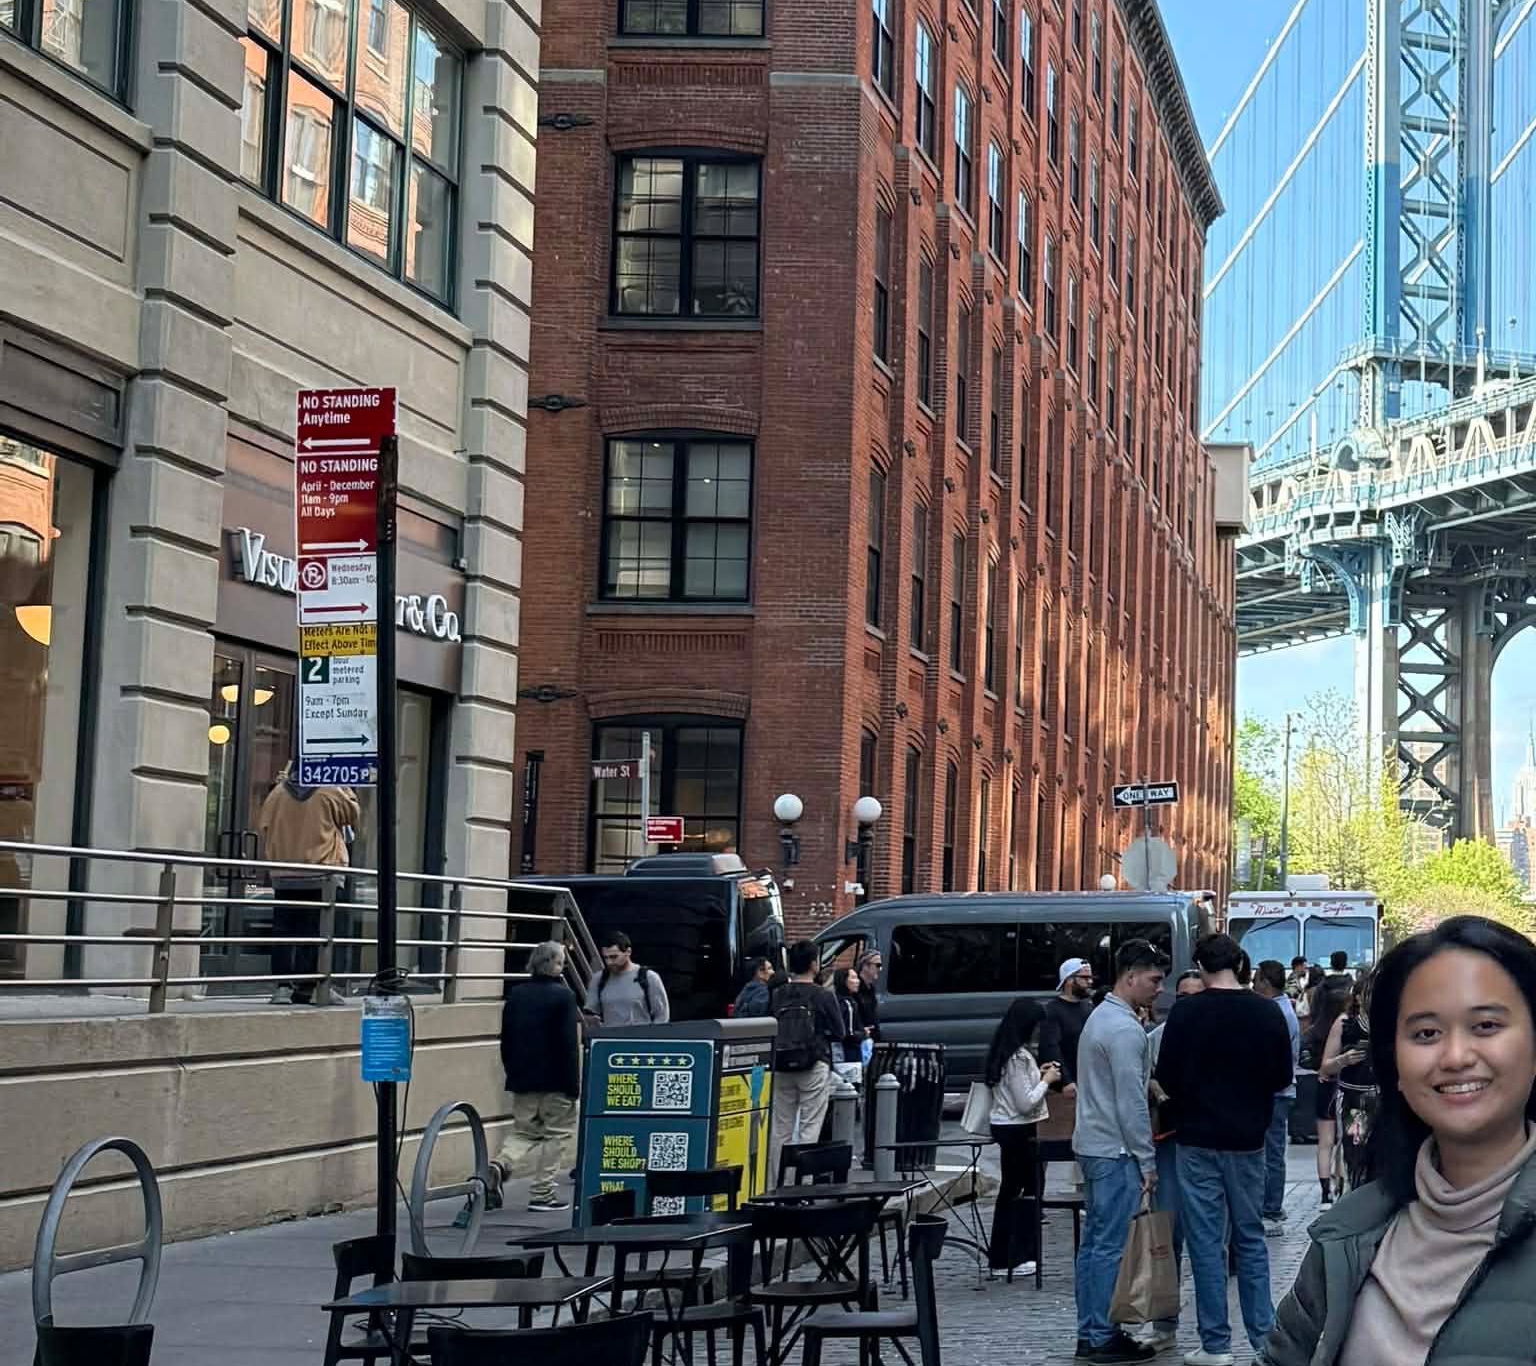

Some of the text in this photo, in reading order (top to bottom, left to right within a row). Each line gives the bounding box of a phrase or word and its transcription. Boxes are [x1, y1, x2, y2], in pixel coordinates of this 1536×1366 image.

[302, 394, 380, 409] NO STANDING
[303, 411, 351, 427] Anytime
[301, 458, 378, 474] NO STANDING
[301, 480, 322, 493] April
[330, 479, 375, 490] December
[302, 494, 321, 505] 11am
[329, 493, 349, 505] 9pm
[301, 506, 336, 519] All Days
[332, 639, 358, 649] Above
[308, 657, 323, 682] 2
[332, 666, 364, 675] metered
[332, 676, 360, 686] parking
[305, 695, 324, 706] 9am
[332, 695, 350, 706] 7pm
[305, 707, 368, 720] Except Sunday
[304, 766, 359, 783] 342705
[592, 765, 630, 778] Water St
[1151, 789, 1169, 797] WAY
[608, 1073, 639, 1083] WHERE
[608, 1084, 641, 1095] SHOULD
[608, 1095, 642, 1107] WE EAT?
[604, 1135, 635, 1146] WHERE
[603, 1146, 637, 1157] SHOULD
[602, 1158, 646, 1170] WE SHOP?
[601, 1180, 625, 1193] WHAT
